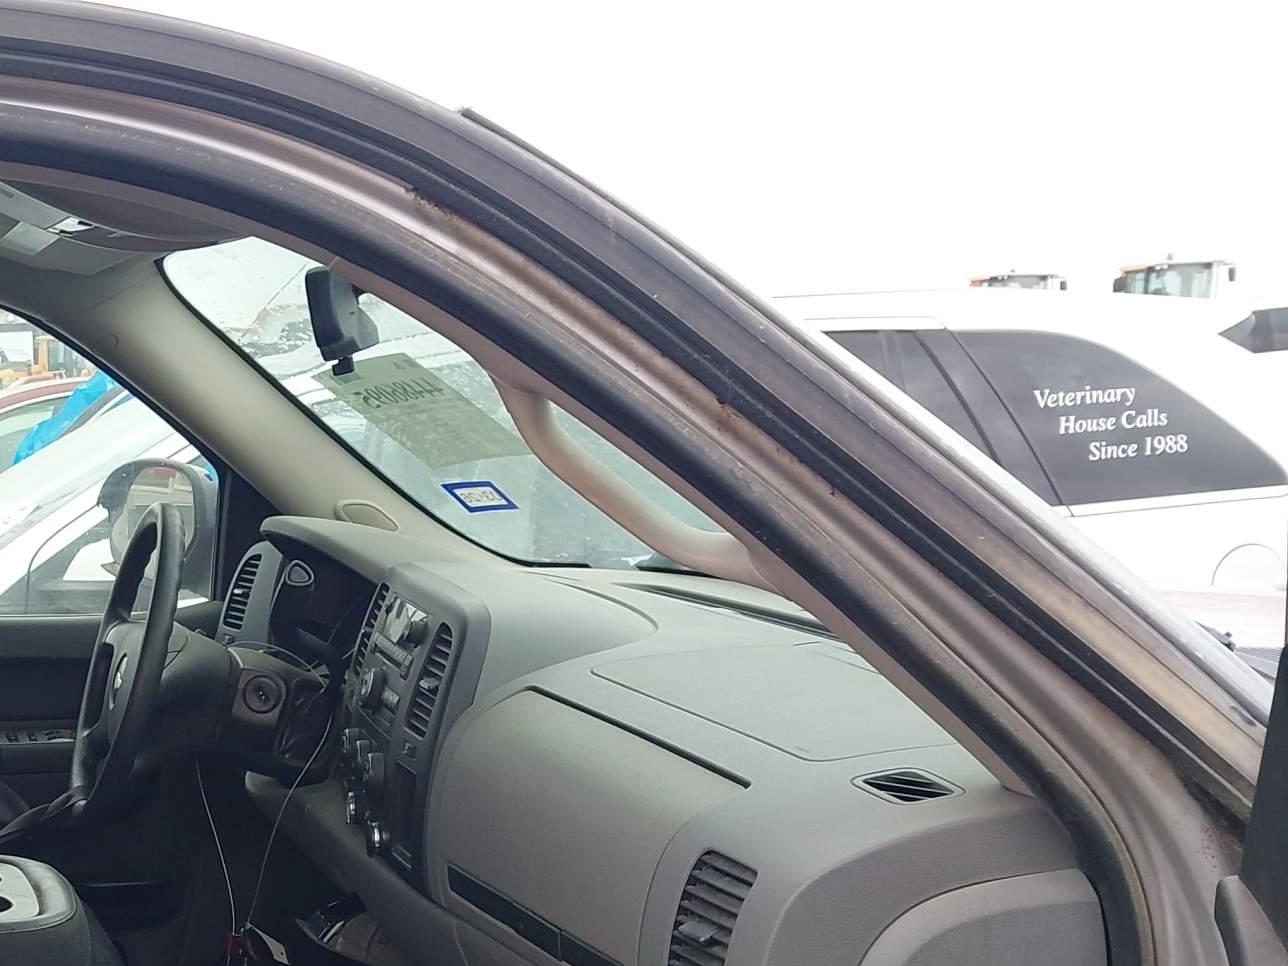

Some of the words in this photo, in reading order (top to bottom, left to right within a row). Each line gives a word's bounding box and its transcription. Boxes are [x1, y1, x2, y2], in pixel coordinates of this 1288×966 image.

[1033, 386, 1136, 408] Veterinary
[1058, 415, 1116, 434] House
[1121, 408, 1168, 429] Calls
[1088, 441, 1138, 460] Since
[1144, 434, 1188, 456] 1988
